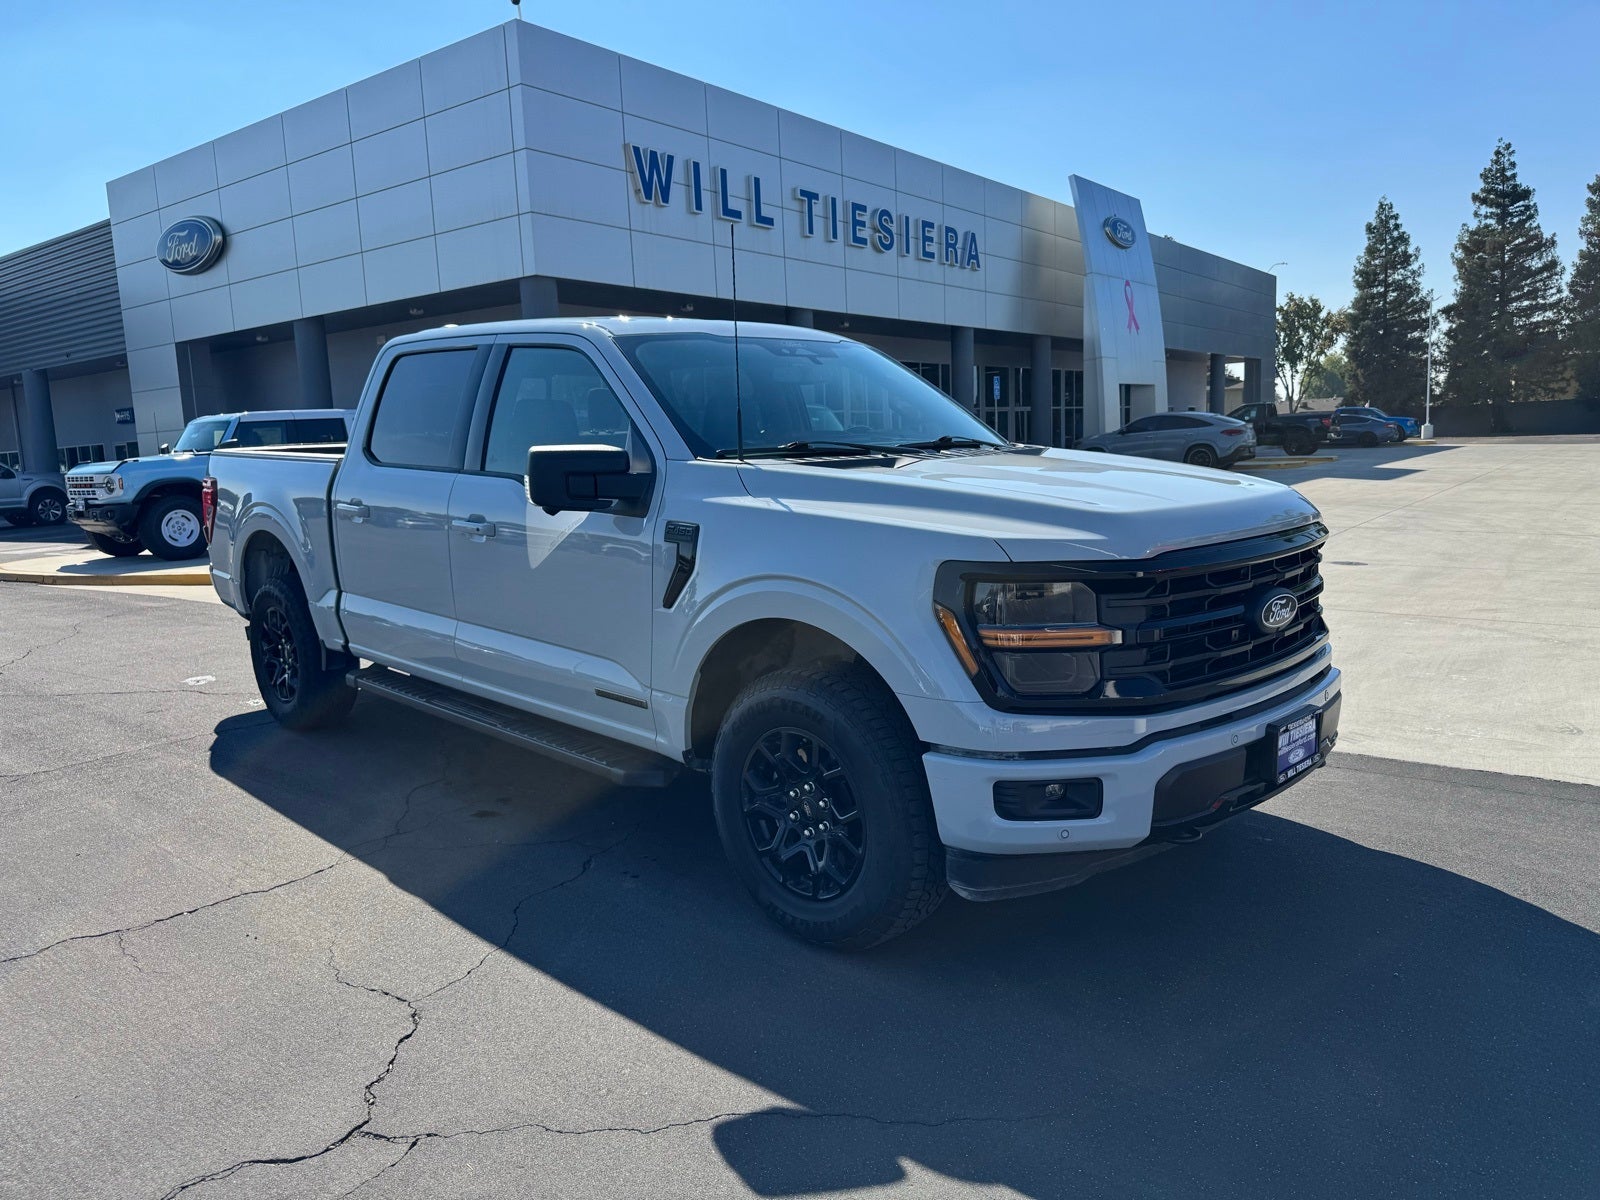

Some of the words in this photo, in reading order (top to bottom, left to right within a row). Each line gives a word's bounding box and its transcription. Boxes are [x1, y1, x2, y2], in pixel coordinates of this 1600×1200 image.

[625, 143, 775, 229] WILL
[795, 186, 981, 271] TIESIERA
[1116, 222, 1132, 241] Ford
[166, 229, 199, 263] Ford
[1269, 599, 1292, 622] Ford
